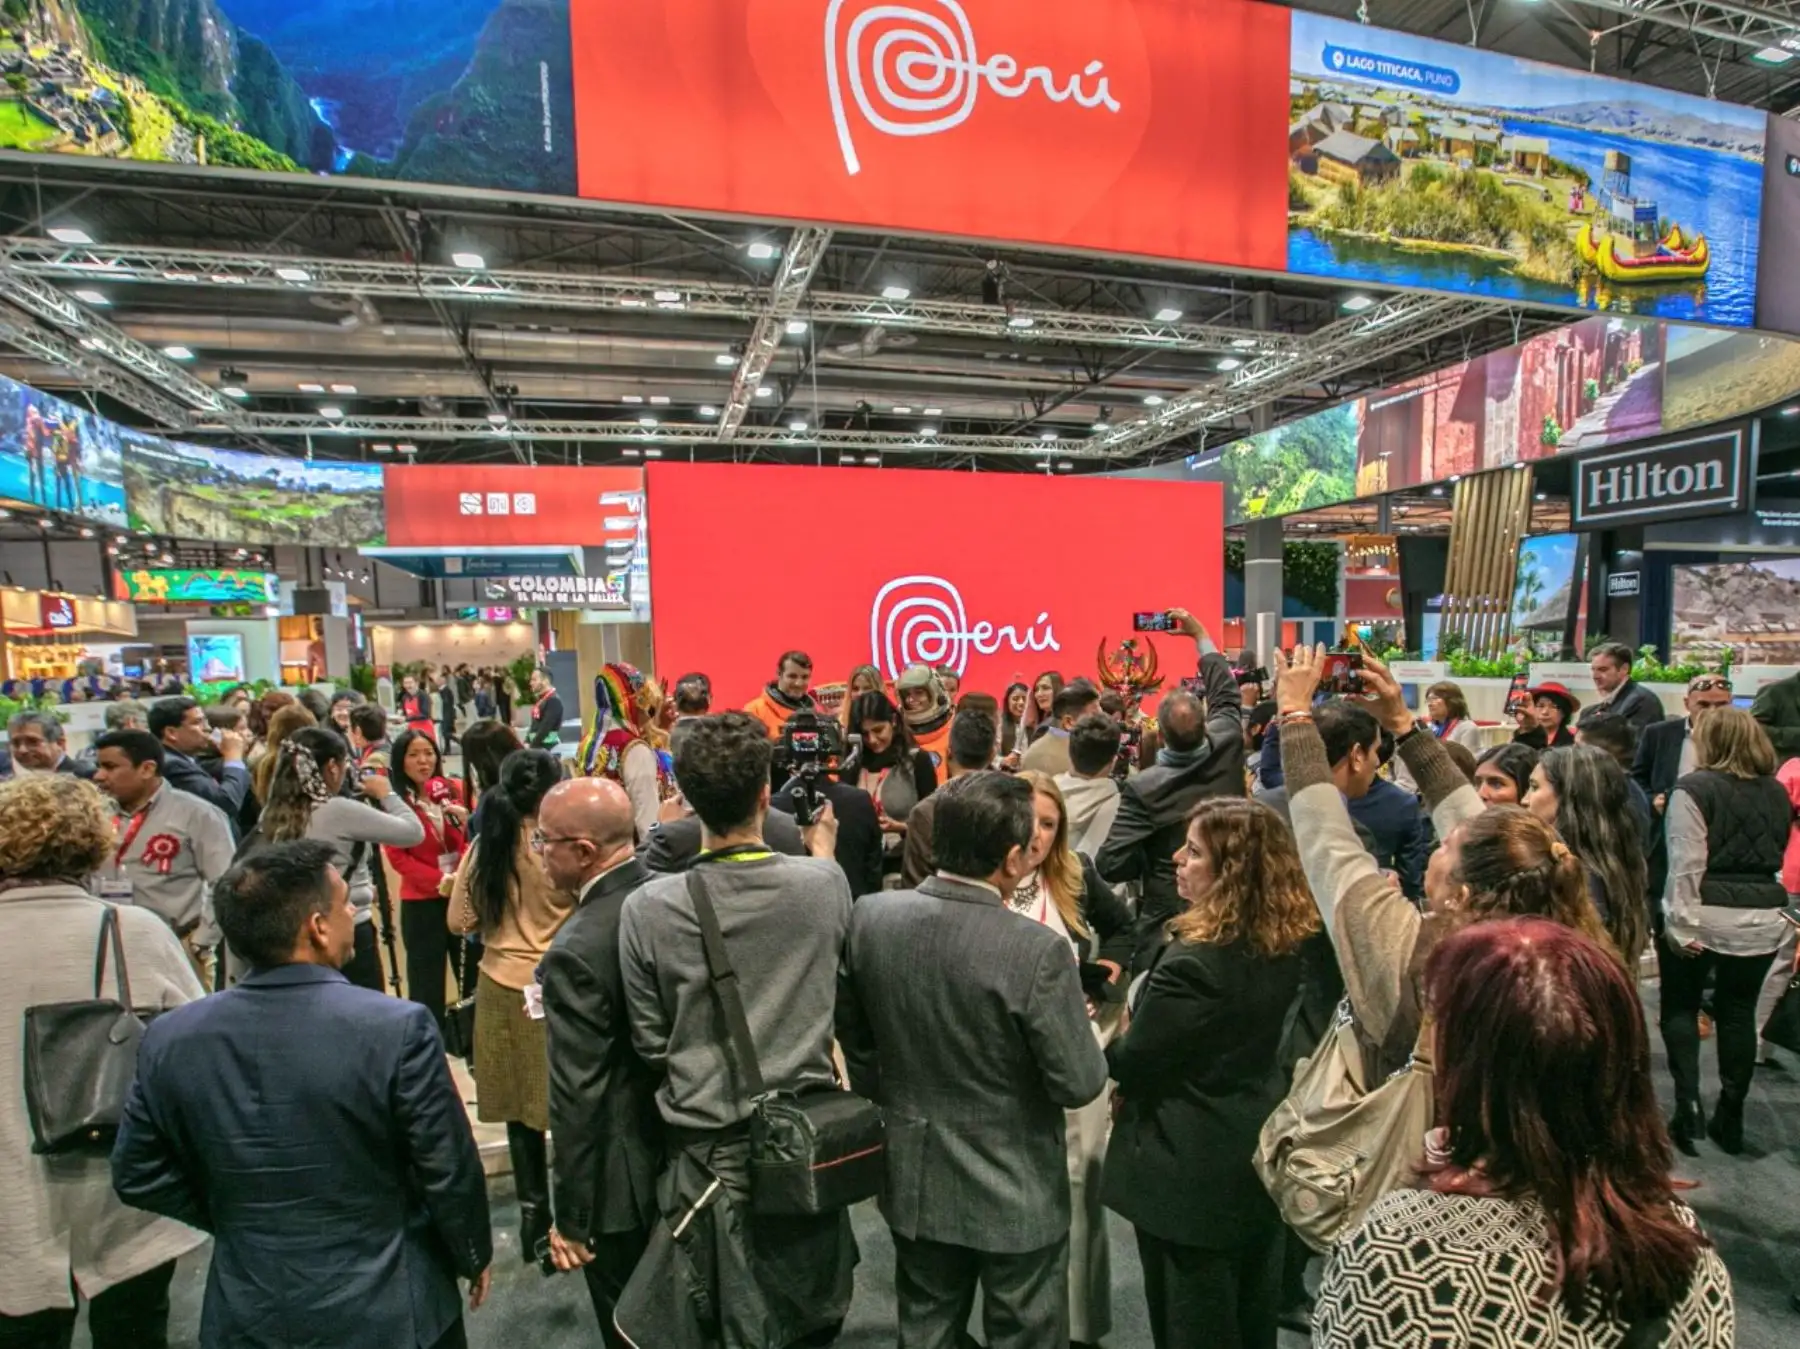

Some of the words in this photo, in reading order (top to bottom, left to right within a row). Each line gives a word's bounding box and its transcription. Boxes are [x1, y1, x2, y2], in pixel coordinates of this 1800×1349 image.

[1346, 54, 1375, 71] LAGO
[1376, 61, 1423, 82] TITICACA,
[1424, 71, 1453, 87] PUNO
[825, 0, 1121, 176] Perú
[1588, 459, 1724, 507] Hilton
[508, 575, 606, 593] COLOMBIA
[517, 592, 529, 602] EL
[556, 593, 568, 602] DE
[572, 593, 585, 603] LA
[588, 593, 625, 604] BELLEZA
[1610, 577, 1637, 590] Hilton
[871, 575, 1061, 681] Perú
